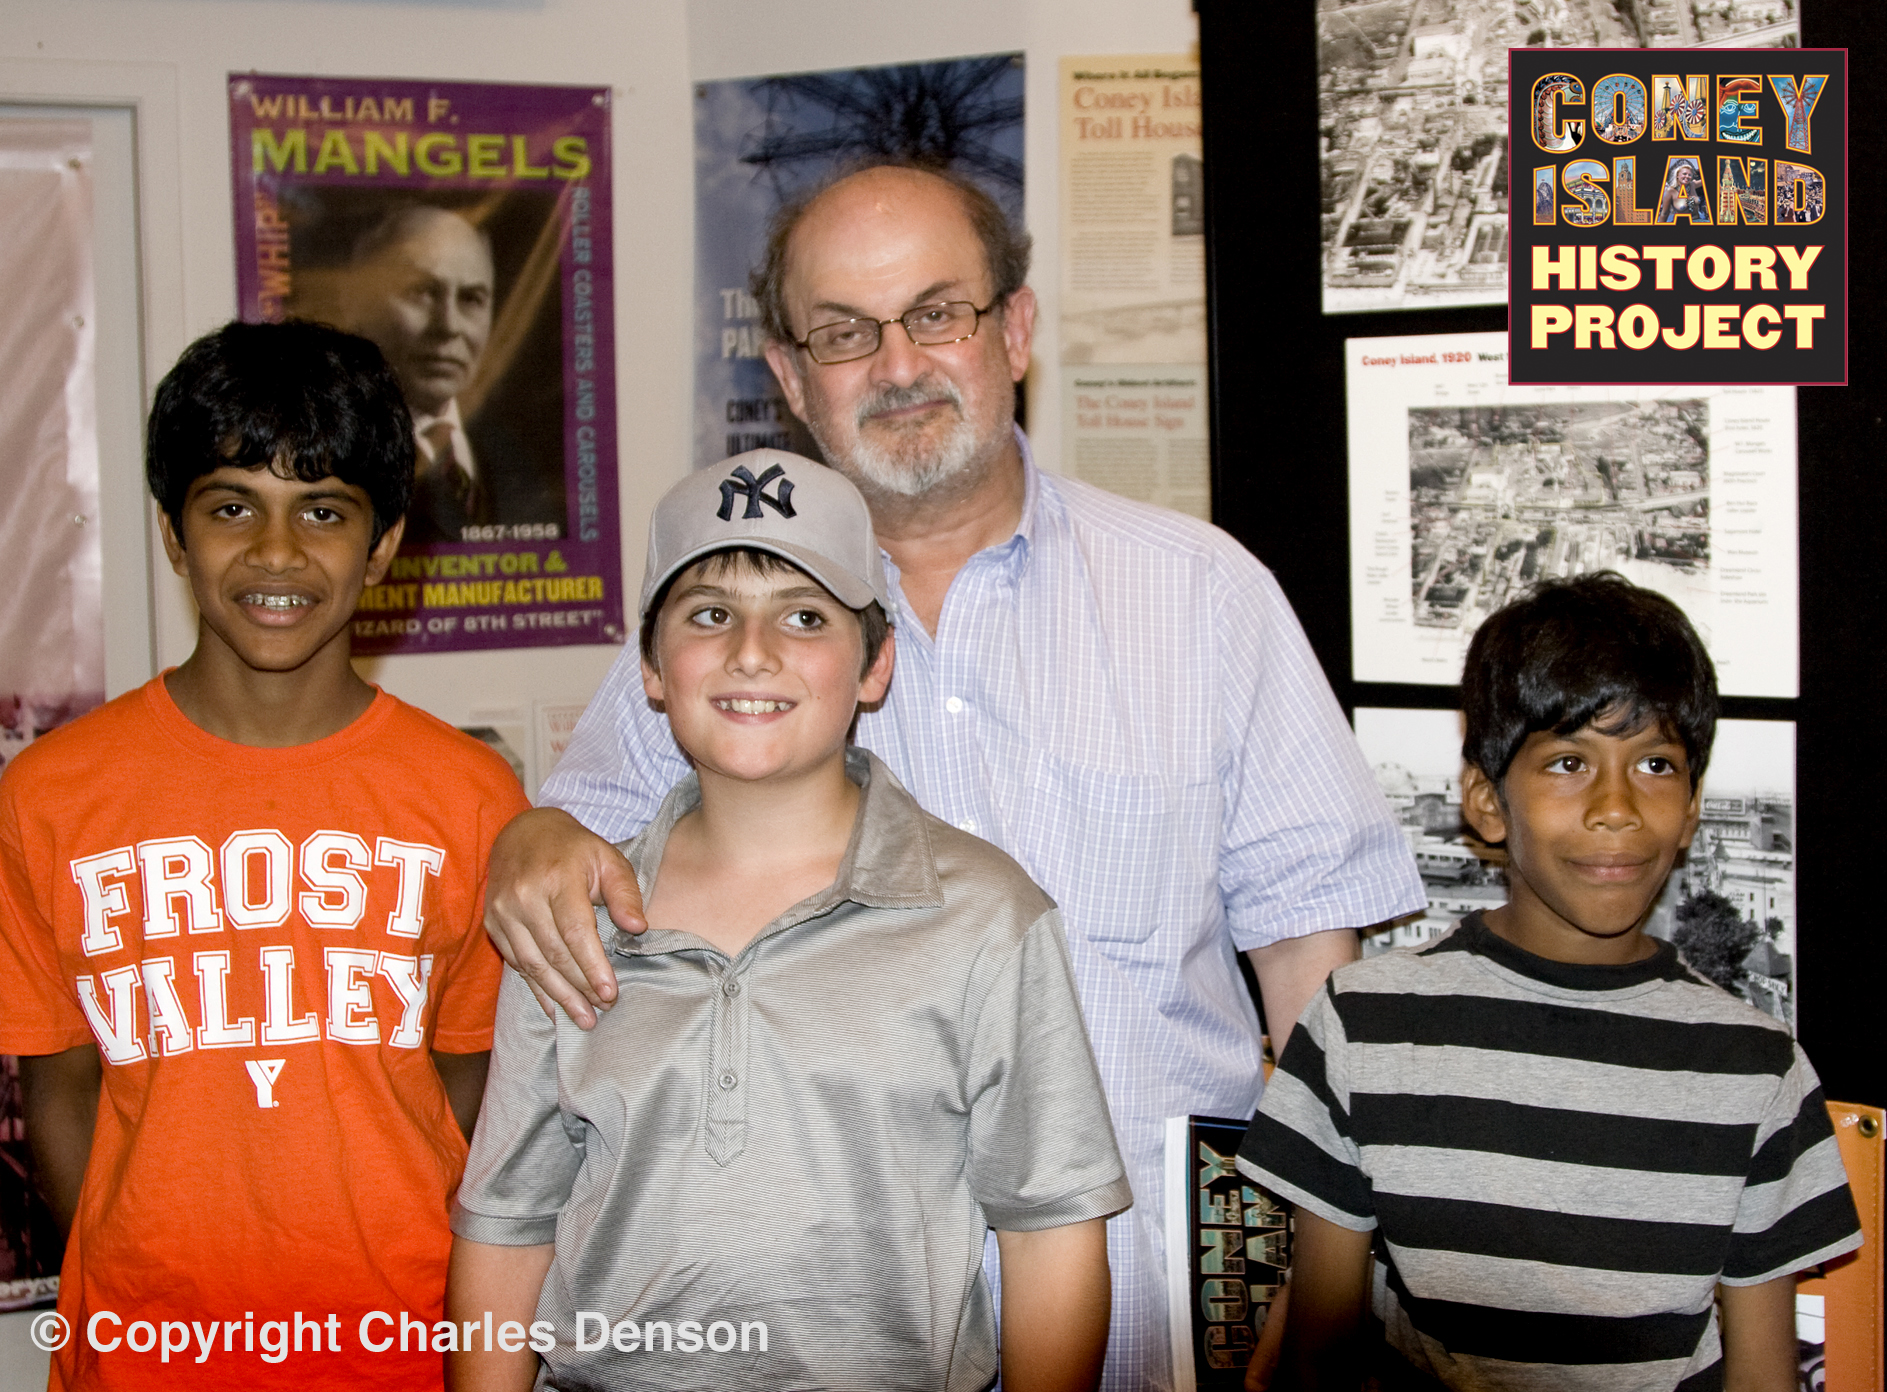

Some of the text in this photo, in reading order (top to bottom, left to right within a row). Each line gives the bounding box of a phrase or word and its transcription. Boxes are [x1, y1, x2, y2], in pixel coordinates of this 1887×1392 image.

[250, 94, 459, 124] WILLIAM F.
[1073, 85, 1152, 114] Coney
[1074, 116, 1124, 139] Toll
[250, 127, 592, 180] MANGELS
[571, 186, 599, 542] ROLLER COASTERS AND CAROUSELS
[1362, 355, 1396, 368] Coney
[1442, 351, 1472, 363] 1920
[1478, 351, 1504, 362] West
[461, 522, 560, 543] 1867-1958
[391, 550, 568, 579] INVENTOR &
[422, 576, 603, 609] MANUFACTURER
[427, 616, 459, 634] OF
[464, 614, 508, 633] 8TH
[70, 829, 446, 957] FROST
[76, 945, 434, 1066] VALLEY
[1199, 1141, 1255, 1369] CONEY
